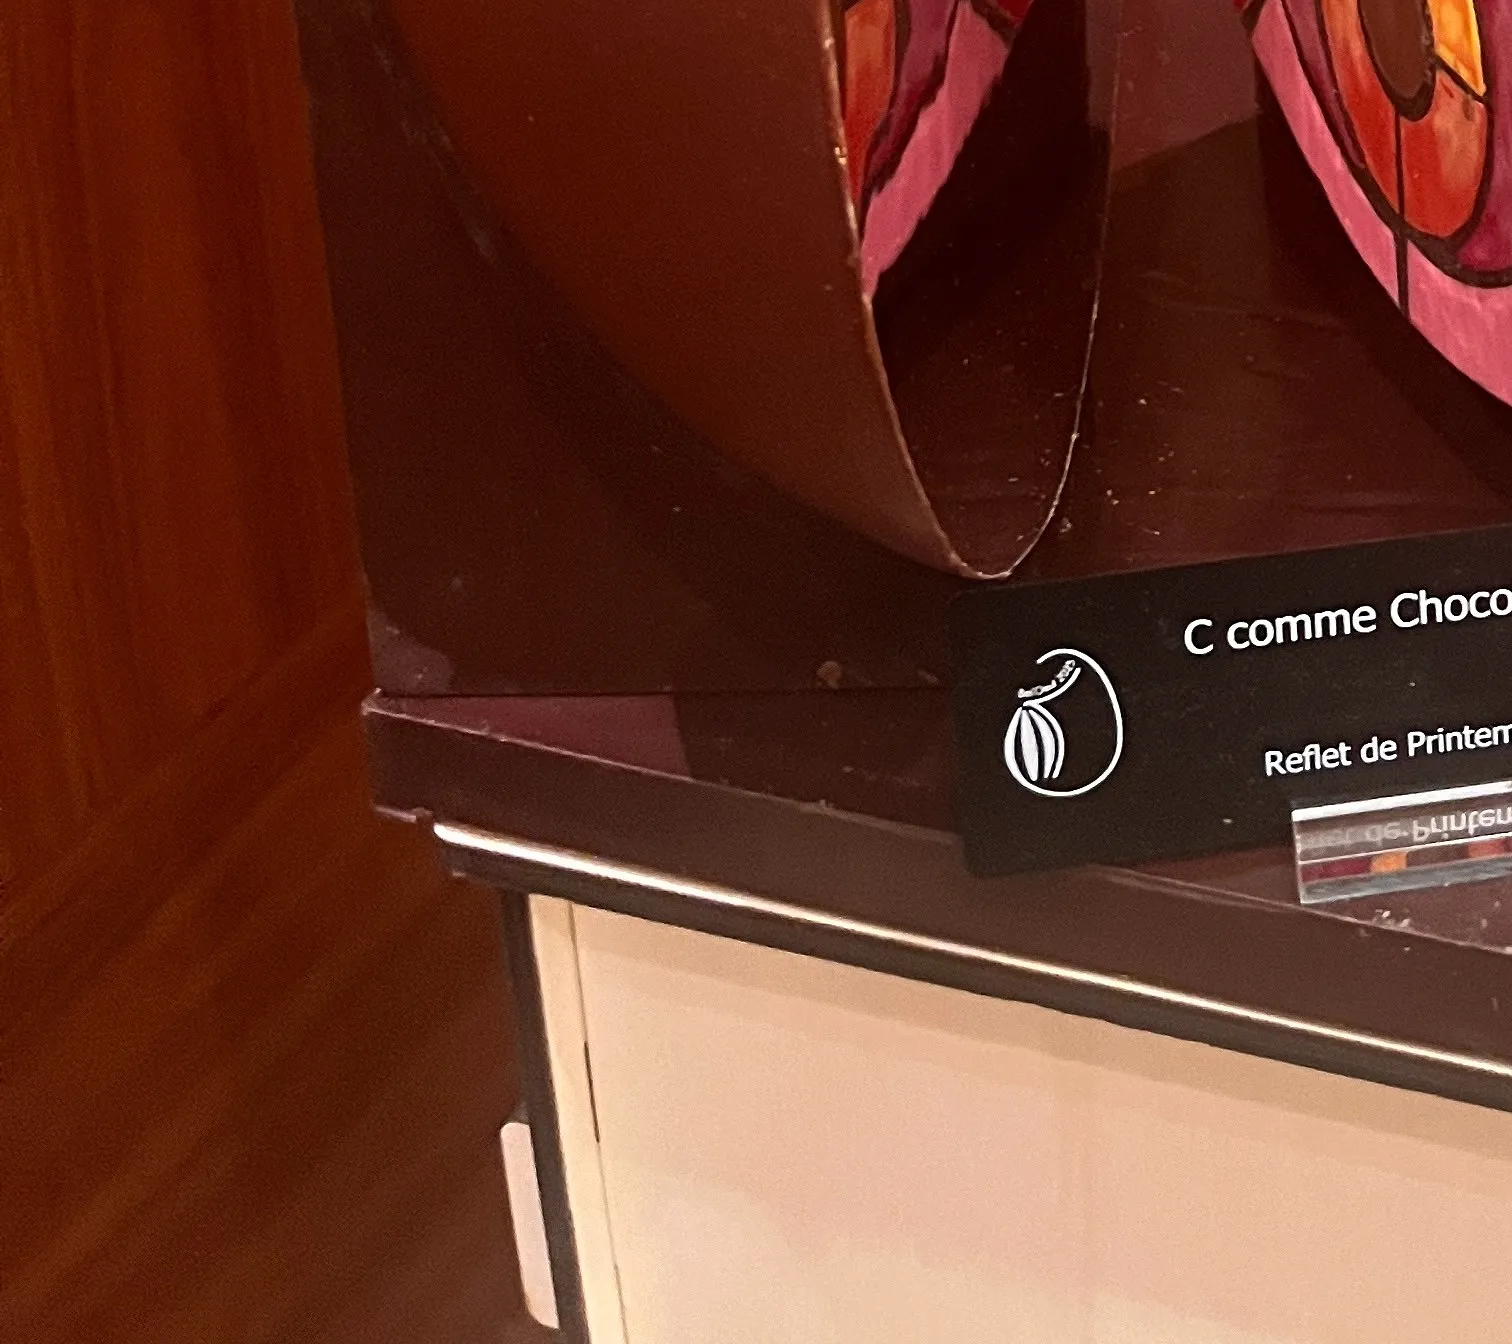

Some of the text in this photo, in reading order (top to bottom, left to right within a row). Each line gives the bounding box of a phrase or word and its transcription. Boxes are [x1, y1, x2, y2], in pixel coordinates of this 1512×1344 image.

[1183, 618, 1214, 655] C
[1226, 605, 1377, 650] comme
[1264, 741, 1353, 777] Reflet
[1360, 735, 1398, 764] de
